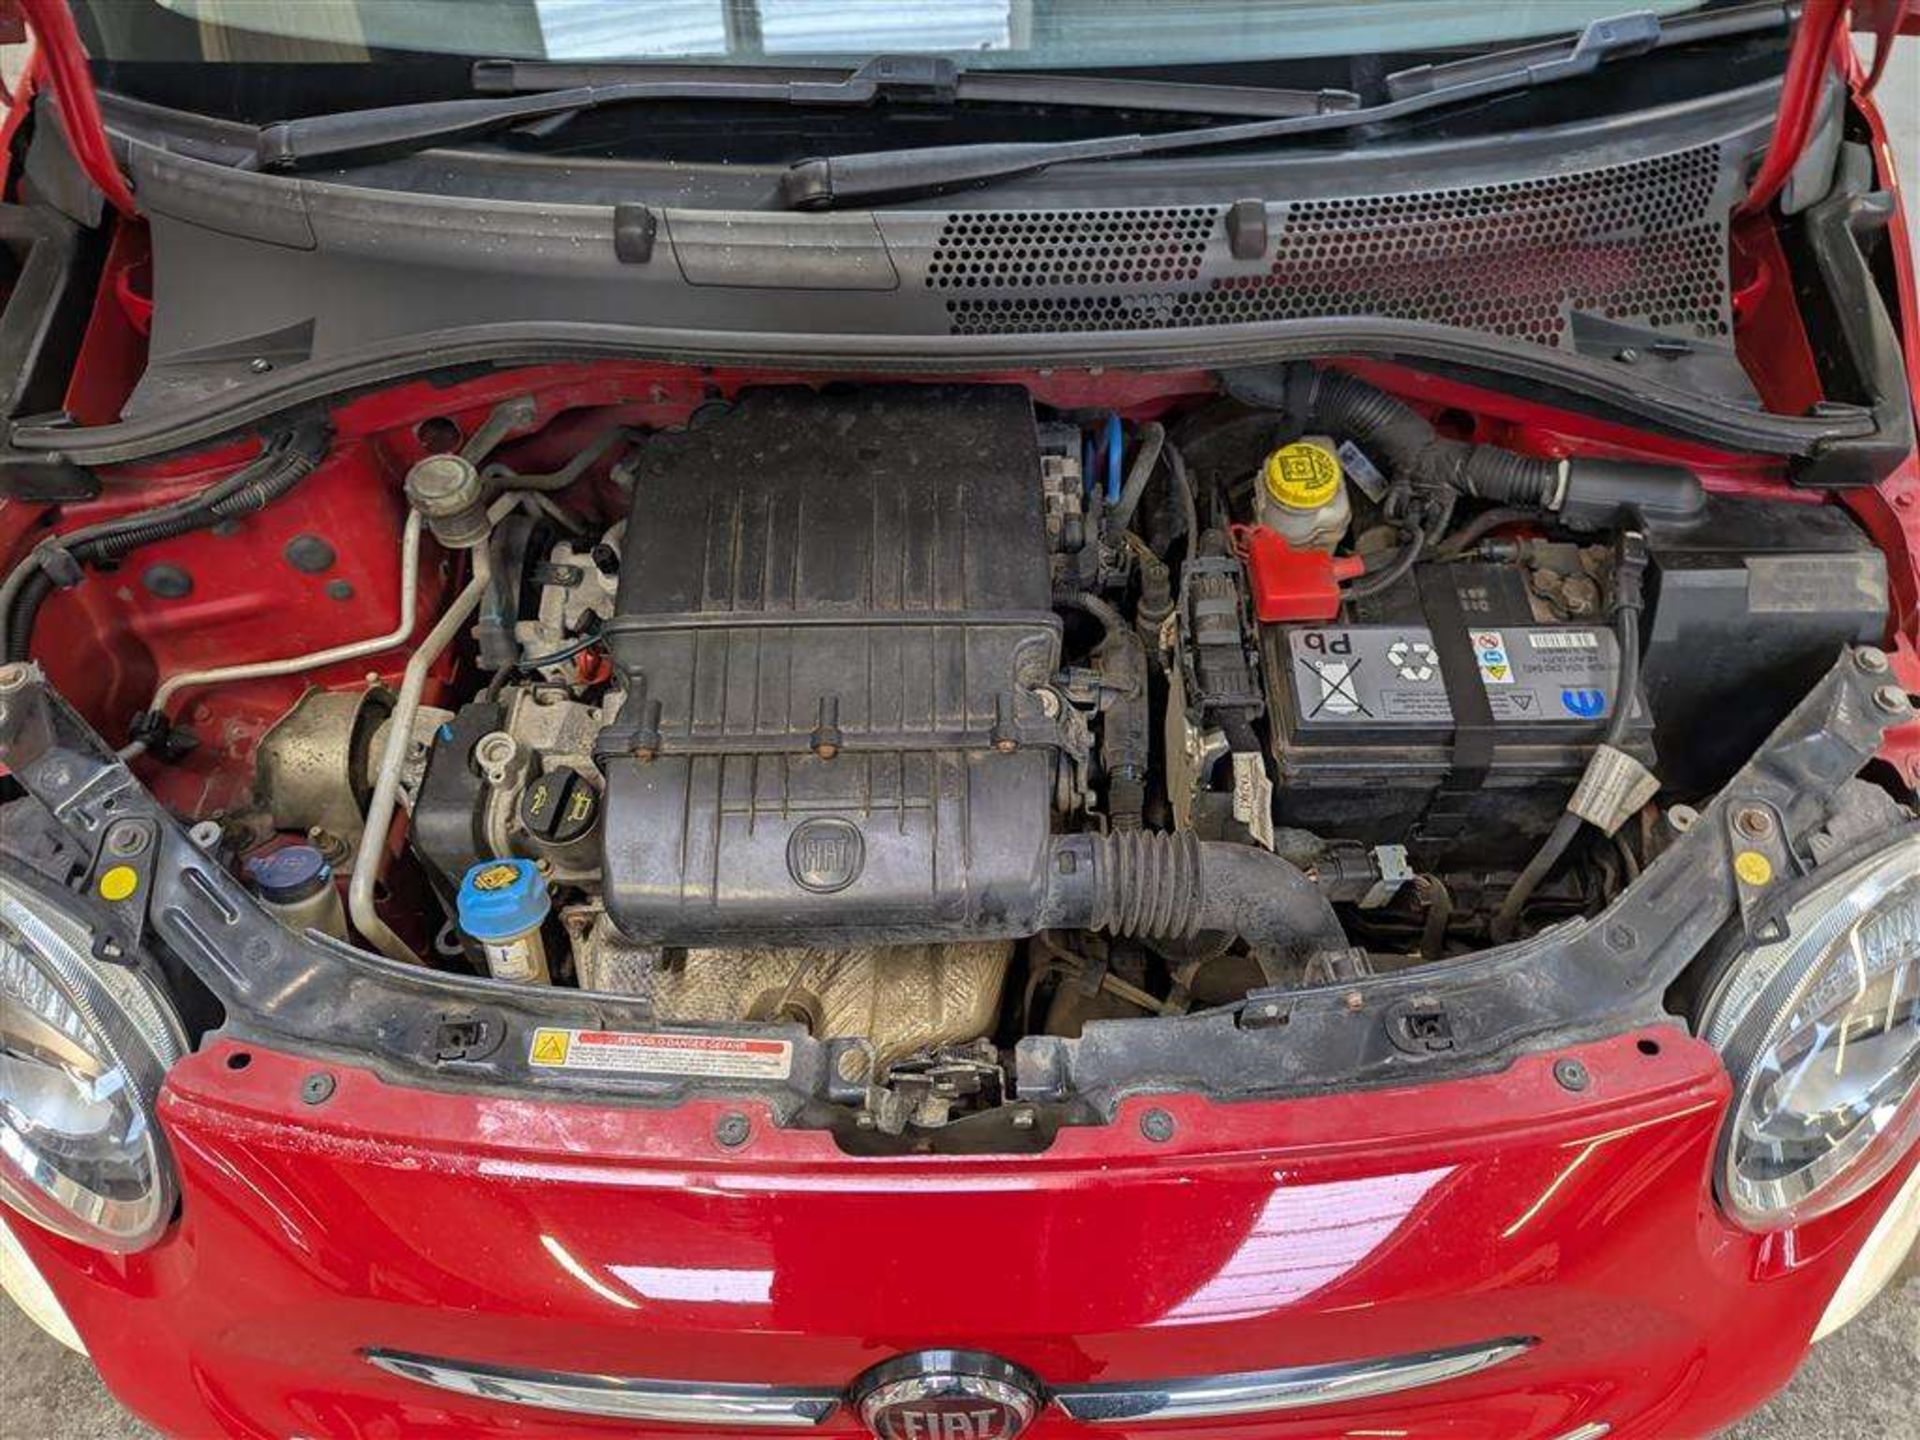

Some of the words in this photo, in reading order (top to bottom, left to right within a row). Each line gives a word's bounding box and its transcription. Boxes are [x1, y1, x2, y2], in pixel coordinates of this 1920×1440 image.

[1304, 632, 1352, 655] Pb
[803, 838, 850, 874] FIAT
[902, 1408, 998, 1440] FIAT
